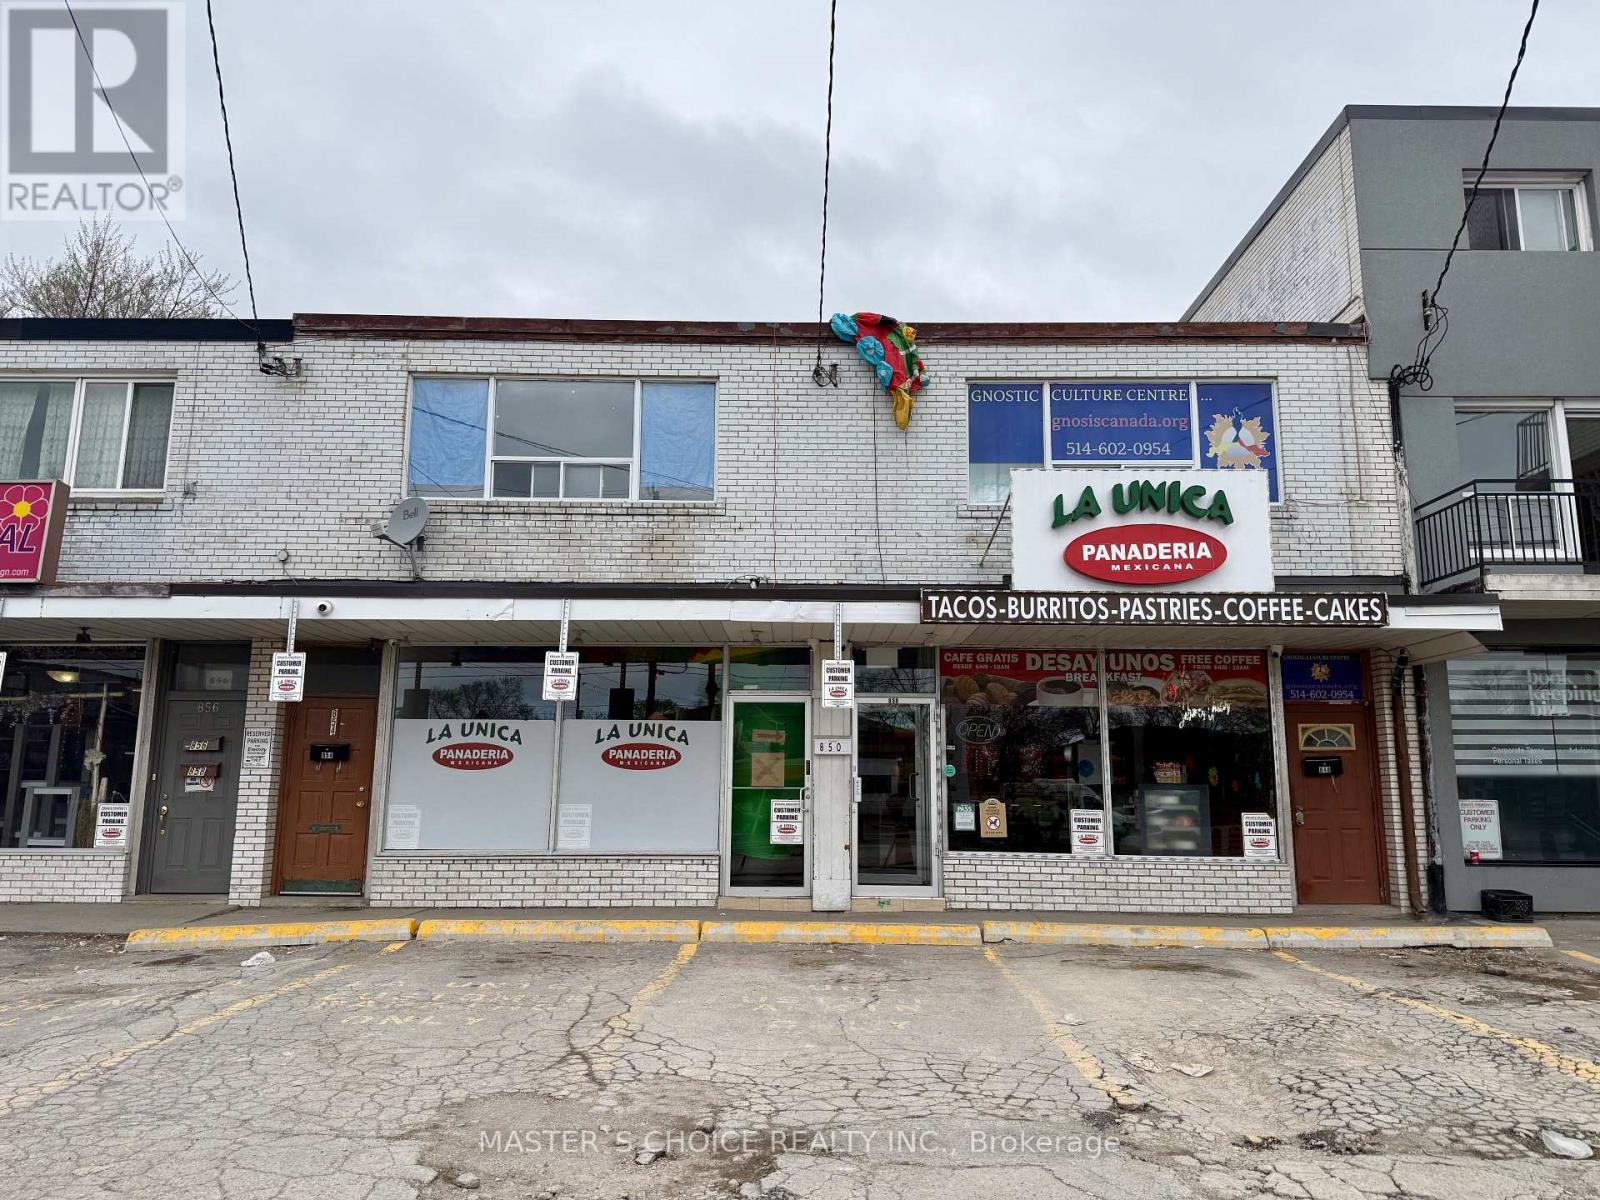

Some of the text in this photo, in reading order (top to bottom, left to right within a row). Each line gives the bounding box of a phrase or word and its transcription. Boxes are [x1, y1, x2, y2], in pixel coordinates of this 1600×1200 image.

[971, 390, 1039, 402] GNOSTIC
[1051, 389, 1121, 402] CULTURE
[1126, 389, 1188, 402] CENTRE
[1051, 412, 1189, 432] gnosiscanada.org
[1066, 442, 1171, 456] 514-602-0954
[1052, 480, 1234, 528] LA UNICA
[403, 506, 418, 520] Bell
[1082, 542, 1212, 561] PANADERIA
[1111, 563, 1194, 572] MEXICANA
[944, 652, 1019, 664] CAFE GRATIS
[1181, 654, 1260, 664] FREE COFFEE
[1290, 690, 1354, 699] 514-602-0954
[198, 702, 219, 712] 856
[426, 722, 522, 746] LA UNICA
[595, 722, 688, 746] LA UNICA
[958, 723, 996, 738] OPEN
[440, 750, 508, 759] PANADERIA
[609, 750, 676, 760] PANADERIA
